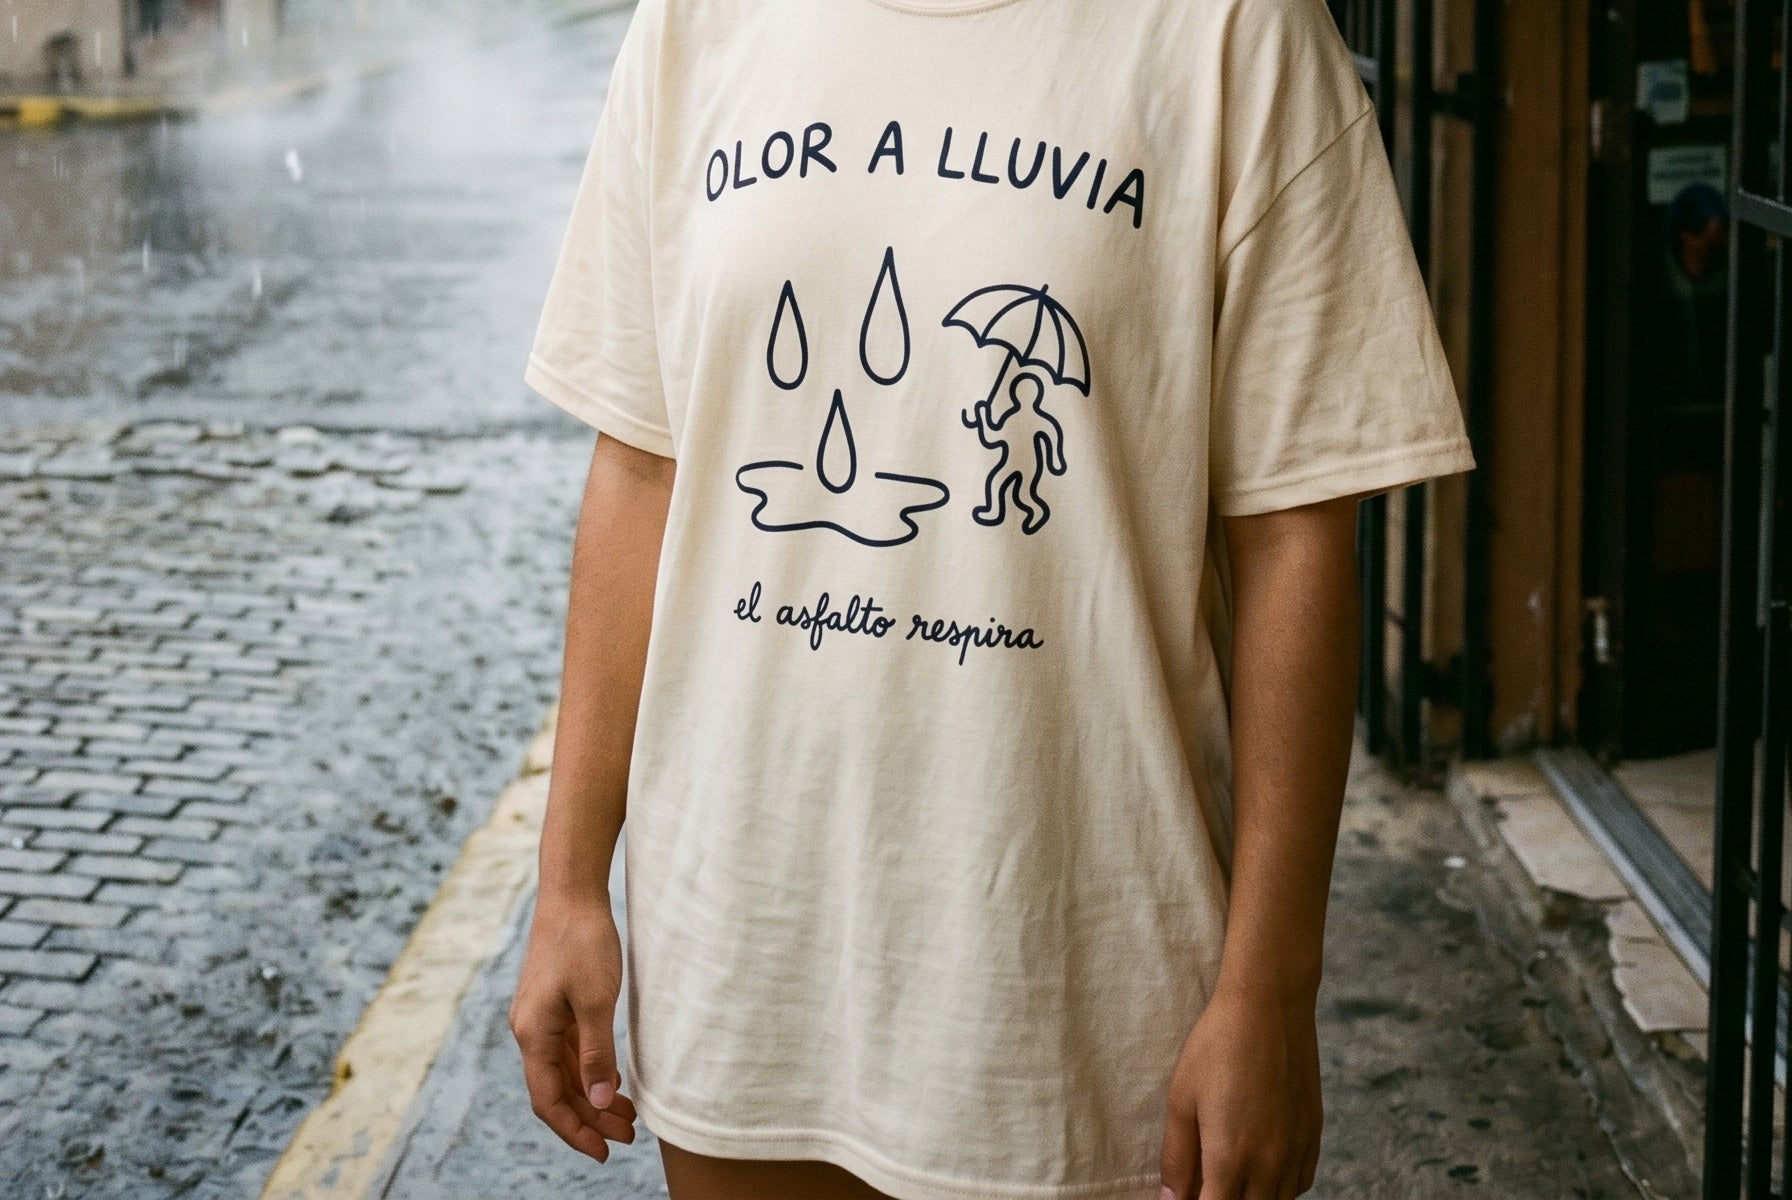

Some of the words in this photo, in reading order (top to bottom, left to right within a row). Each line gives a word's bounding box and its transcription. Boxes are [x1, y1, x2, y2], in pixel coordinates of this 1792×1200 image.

[706, 122, 837, 202] OLOR
[867, 120, 904, 176] A
[937, 126, 1145, 230] LLUVIA
[733, 581, 762, 623] el
[775, 591, 897, 651] asfalto
[905, 614, 1045, 666] respira
